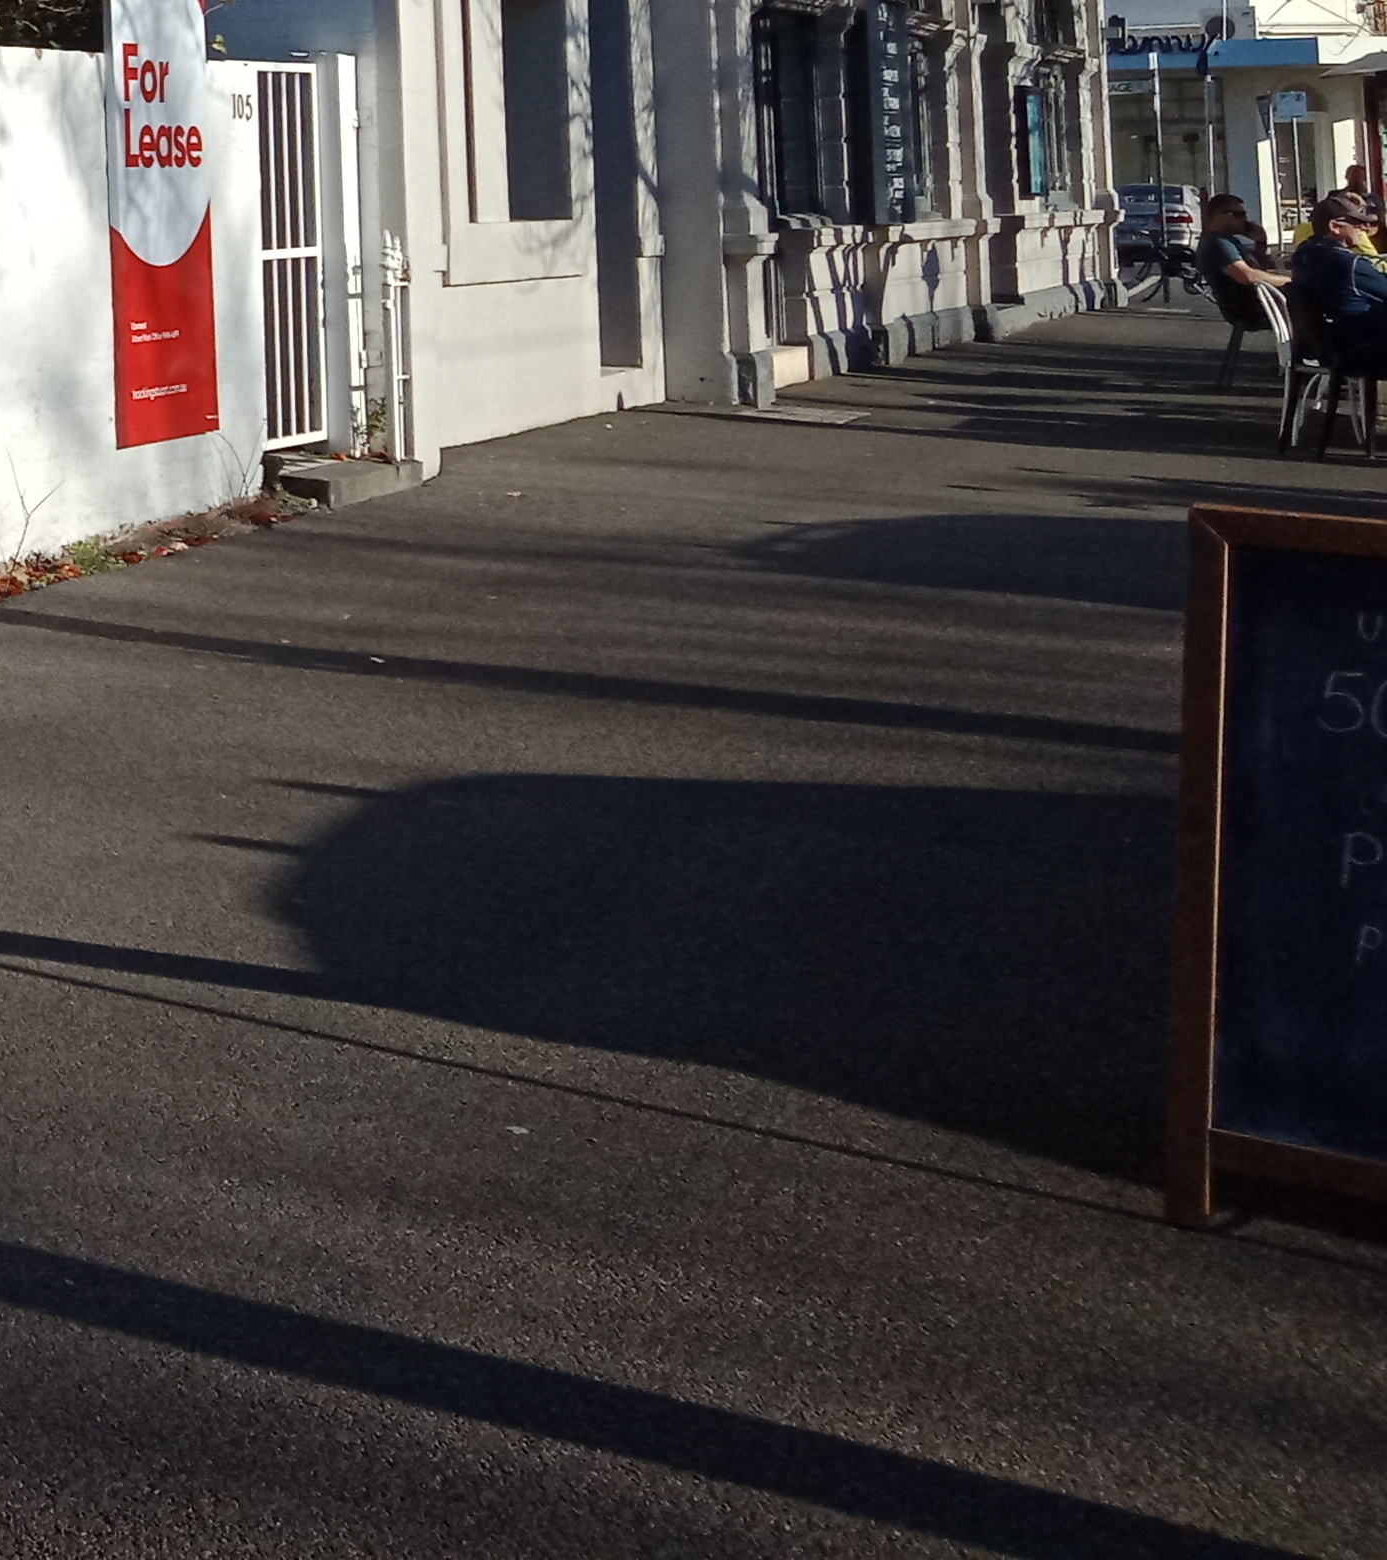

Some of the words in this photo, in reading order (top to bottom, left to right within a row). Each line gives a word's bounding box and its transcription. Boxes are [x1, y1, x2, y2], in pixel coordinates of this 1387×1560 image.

[121, 42, 170, 104] For
[123, 107, 203, 169] Lease
[231, 93, 253, 122] 105
